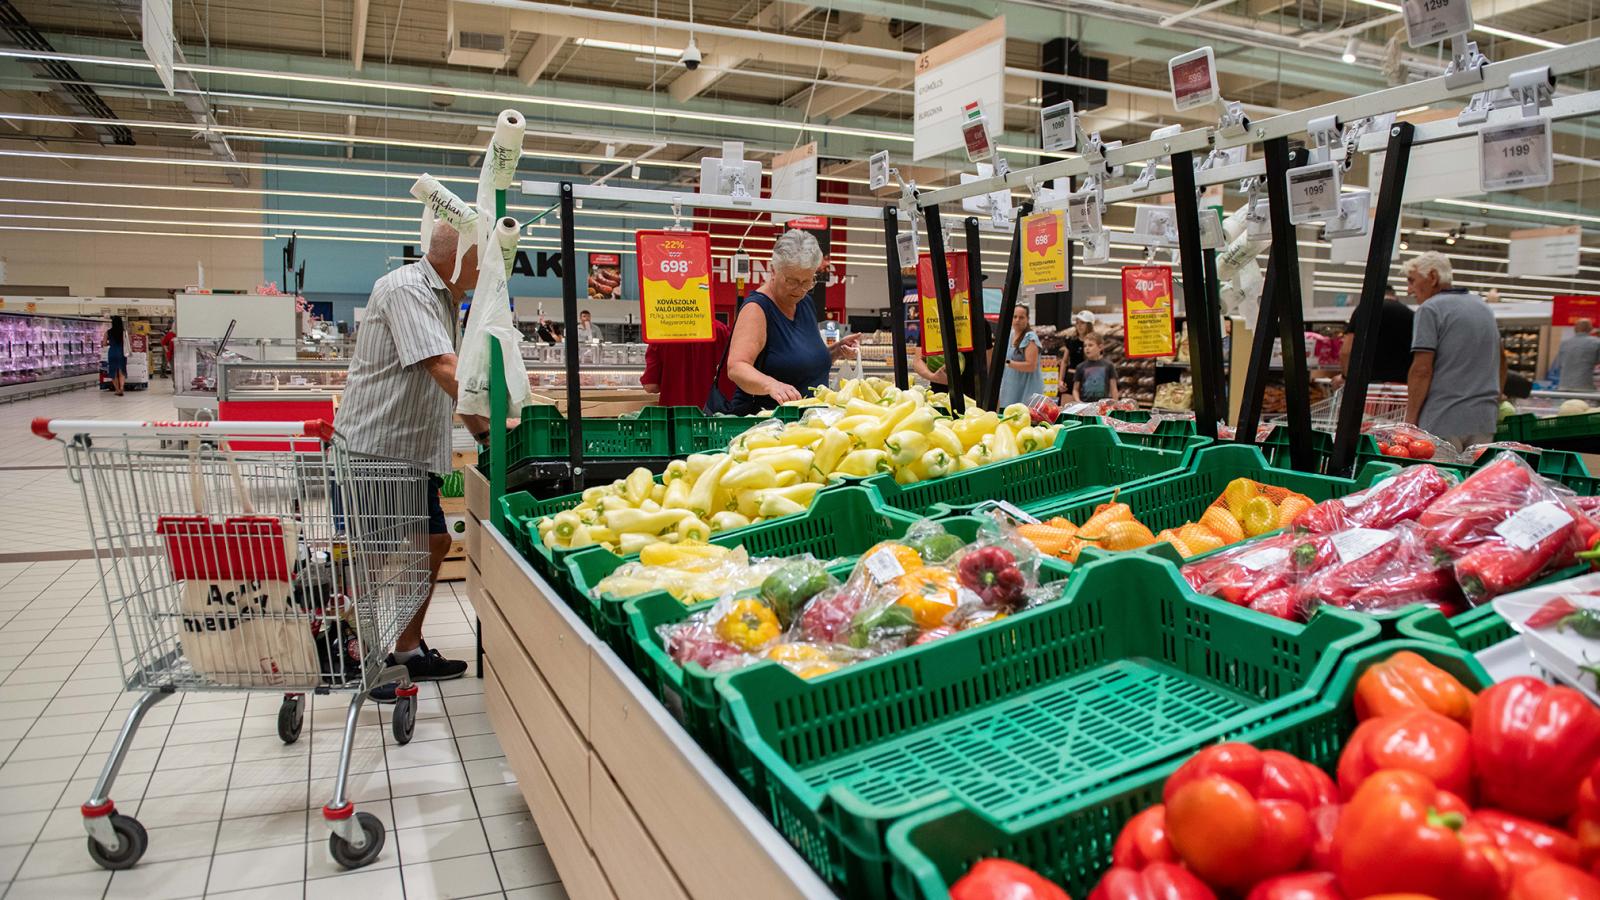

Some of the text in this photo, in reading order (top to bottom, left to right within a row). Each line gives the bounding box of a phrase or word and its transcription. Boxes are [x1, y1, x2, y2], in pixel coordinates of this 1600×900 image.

[1502, 144, 1530, 157] 1199
[1304, 184, 1324, 196] 1099
[428, 190, 464, 219] Auchan
[660, 260, 688, 273] 698
[657, 297, 697, 305] KOVÁSZOLNI
